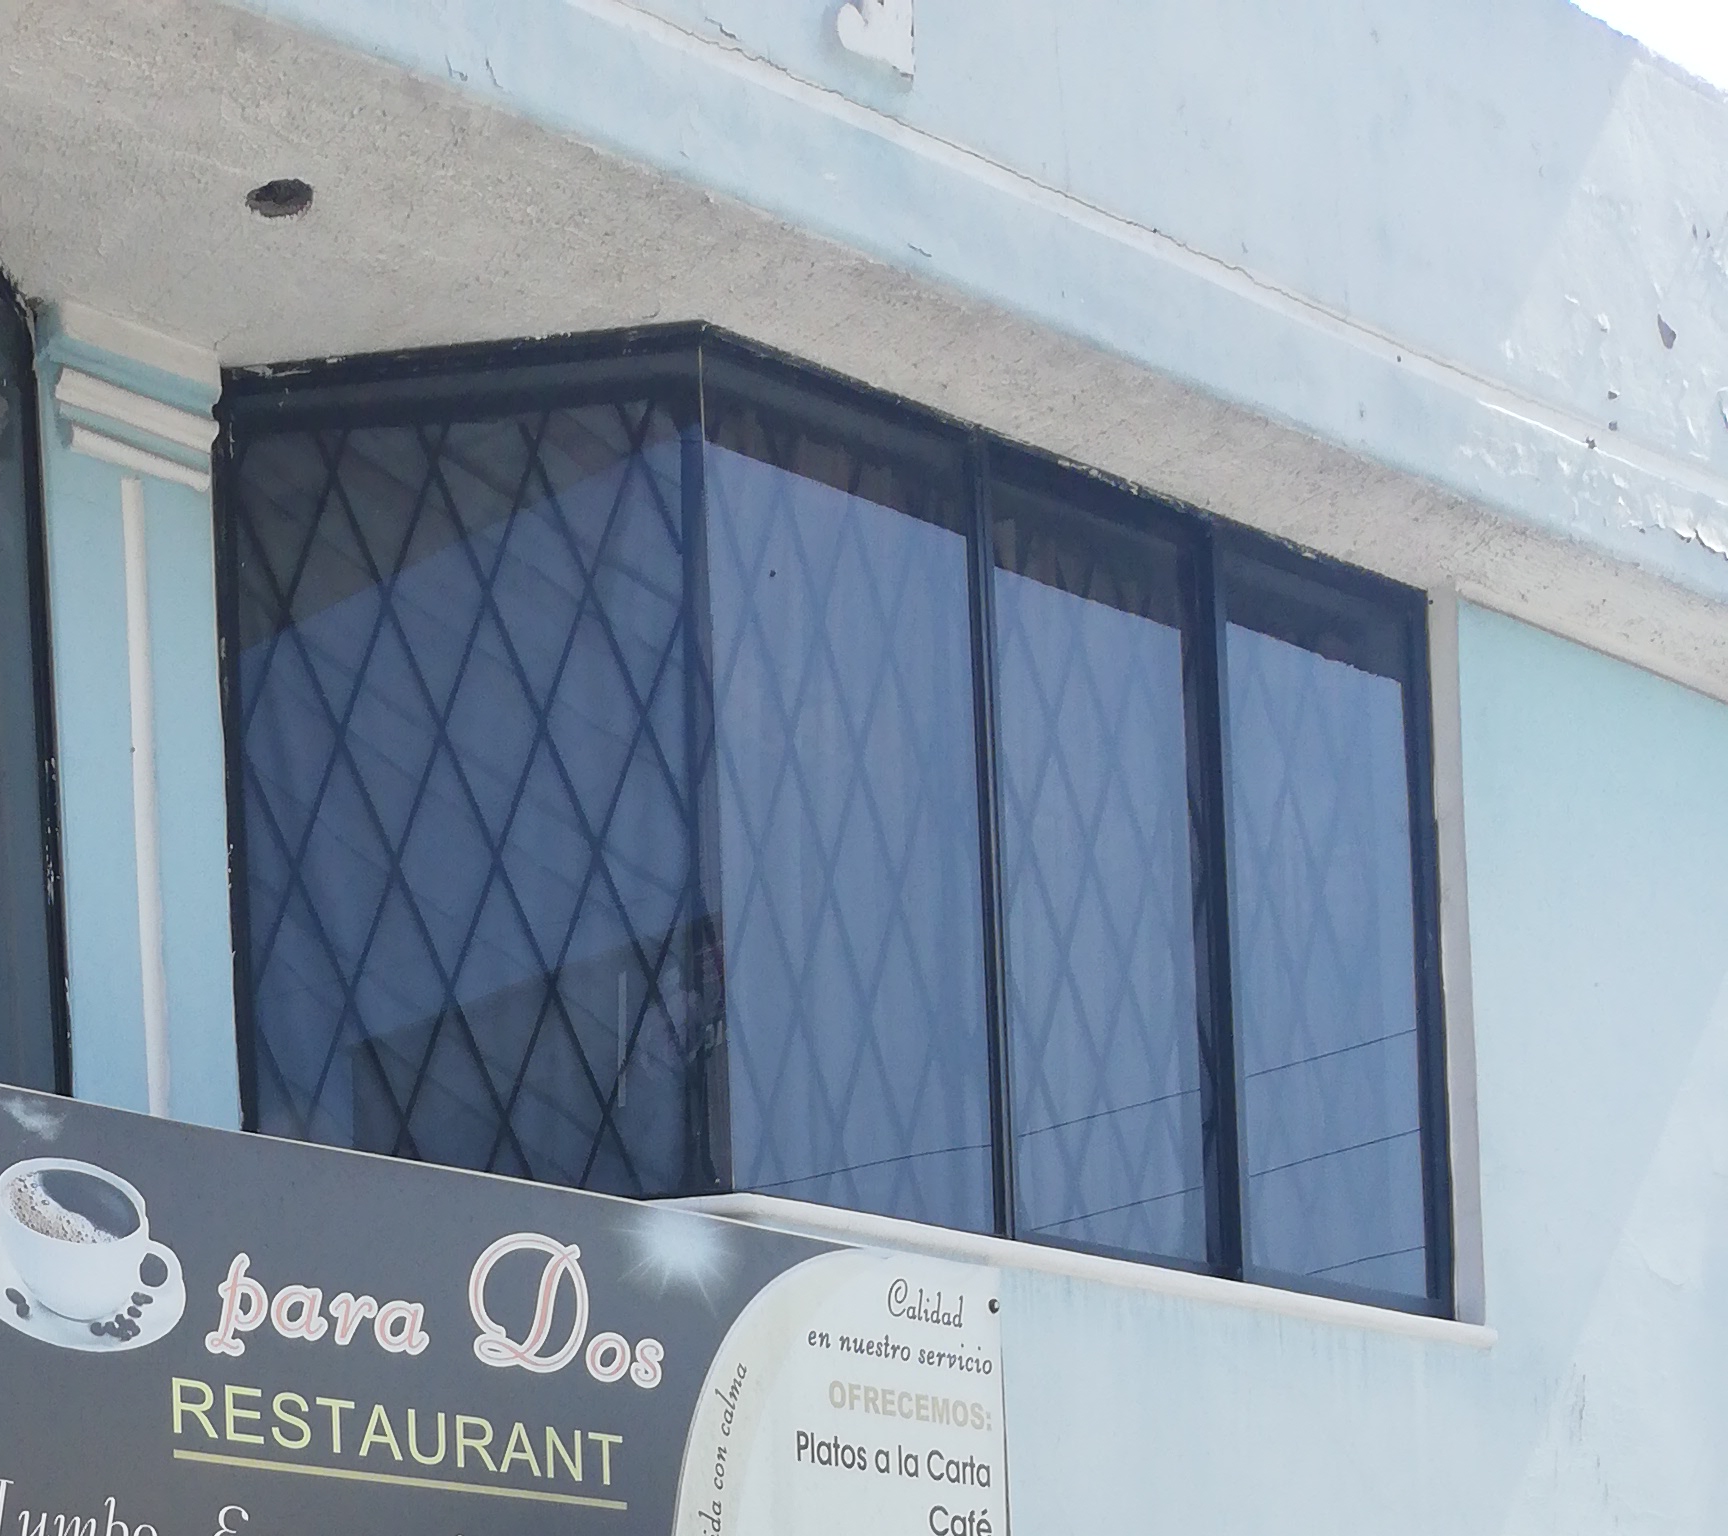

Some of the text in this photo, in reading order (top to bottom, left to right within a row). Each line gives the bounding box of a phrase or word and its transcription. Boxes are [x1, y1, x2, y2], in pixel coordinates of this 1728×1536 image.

[205, 1253, 430, 1356] para
[469, 1233, 664, 1389] Dos
[888, 1278, 963, 1328] Calidad
[808, 1329, 993, 1375] en nuestro servicio
[715, 1362, 747, 1437] calma
[829, 1380, 992, 1431] OFRECEMOS:
[172, 1377, 623, 1485] RESTAURANT
[713, 1446, 728, 1490] con
[796, 1430, 991, 1488] Platos a la Carta
